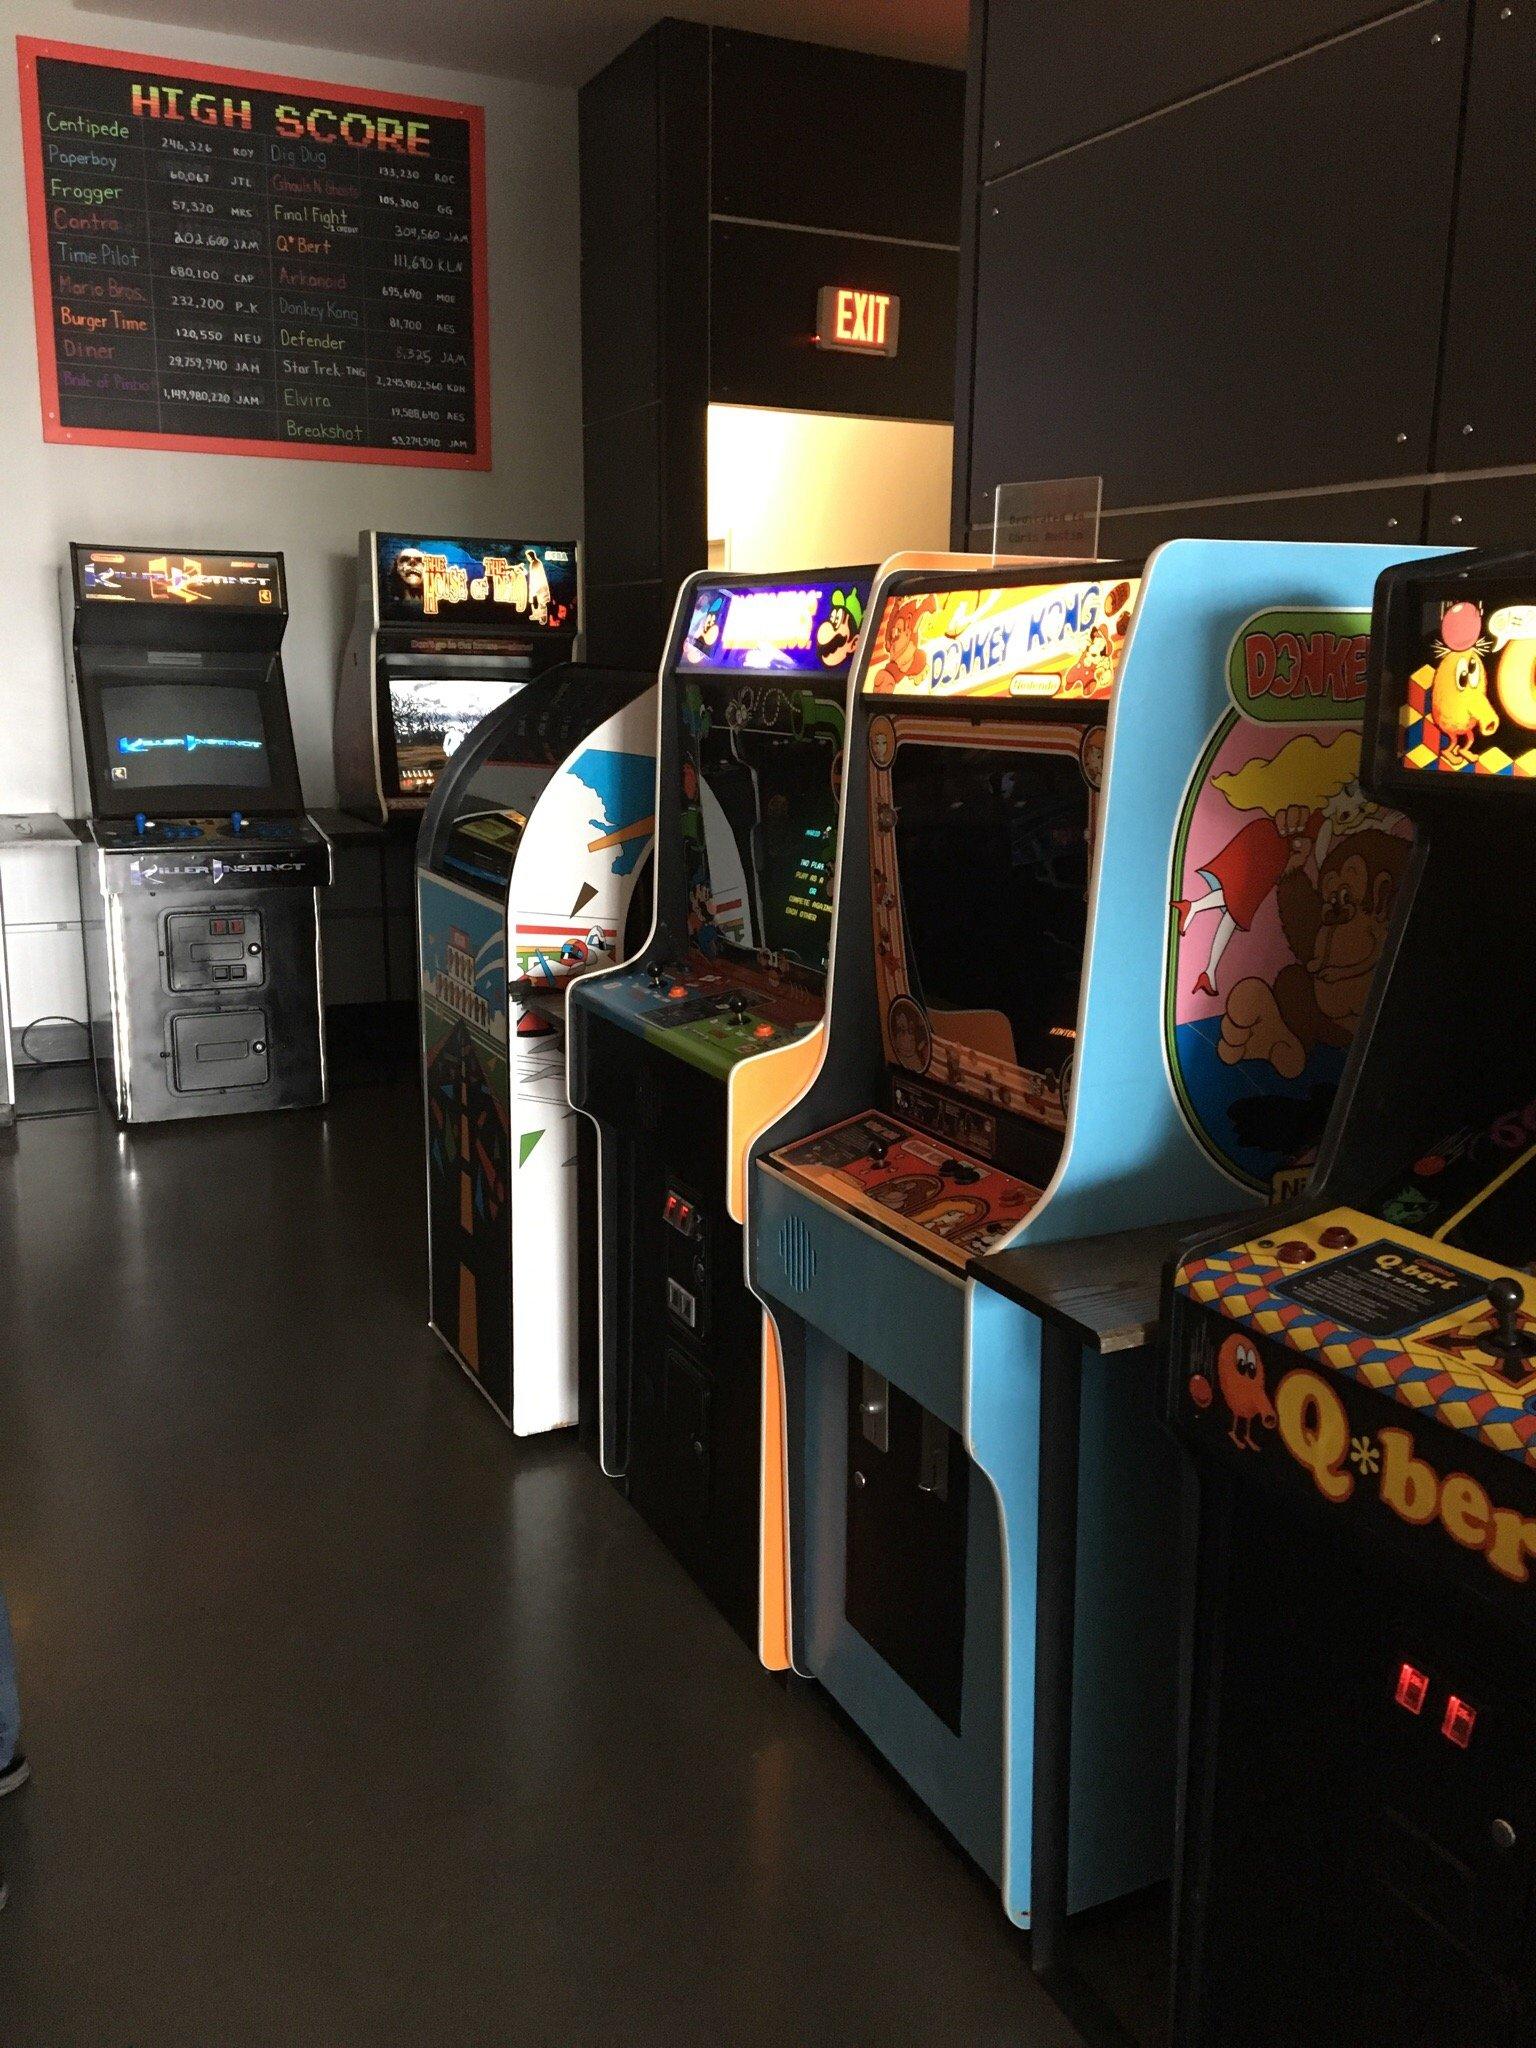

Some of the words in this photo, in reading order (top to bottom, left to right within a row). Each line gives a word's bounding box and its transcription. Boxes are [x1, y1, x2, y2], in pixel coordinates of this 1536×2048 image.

[46, 111, 130, 139] Centipede
[131, 83, 253, 130] HIGH
[275, 104, 430, 158] SCORE
[48, 144, 117, 171] Paperboy
[270, 144, 294, 166] Dig
[300, 146, 327, 169] Dug
[50, 178, 124, 205] Frogger
[53, 207, 120, 230] Contra
[233, 239, 260, 252] JAM
[274, 204, 308, 223] Final
[312, 206, 348, 230] Fight
[57, 241, 97, 264] Time
[101, 243, 140, 267] Pilot
[170, 265, 219, 281] 680,100
[234, 274, 255, 283] CAP
[171, 295, 224, 310] 232,200
[279, 296, 325, 320] Donkey
[60, 306, 107, 332] Burger
[110, 308, 149, 331] Time
[176, 328, 223, 341] 120,550
[234, 332, 262, 345] NEU
[836, 289, 890, 344] EXIT
[280, 328, 346, 350] Defender
[283, 359, 309, 375] Star
[313, 360, 342, 377] Trek
[346, 365, 366, 378] TNG
[235, 395, 259, 406] JAM
[284, 388, 332, 408] Elvira
[287, 419, 363, 441] Breakshot
[449, 440, 468, 449] JAM
[929, 623, 1015, 689] DONKEY
[1027, 585, 1101, 652] KONG
[1244, 631, 1371, 702] DONKE
[130, 860, 209, 885] KILLER
[212, 858, 305, 884] INSTINCT
